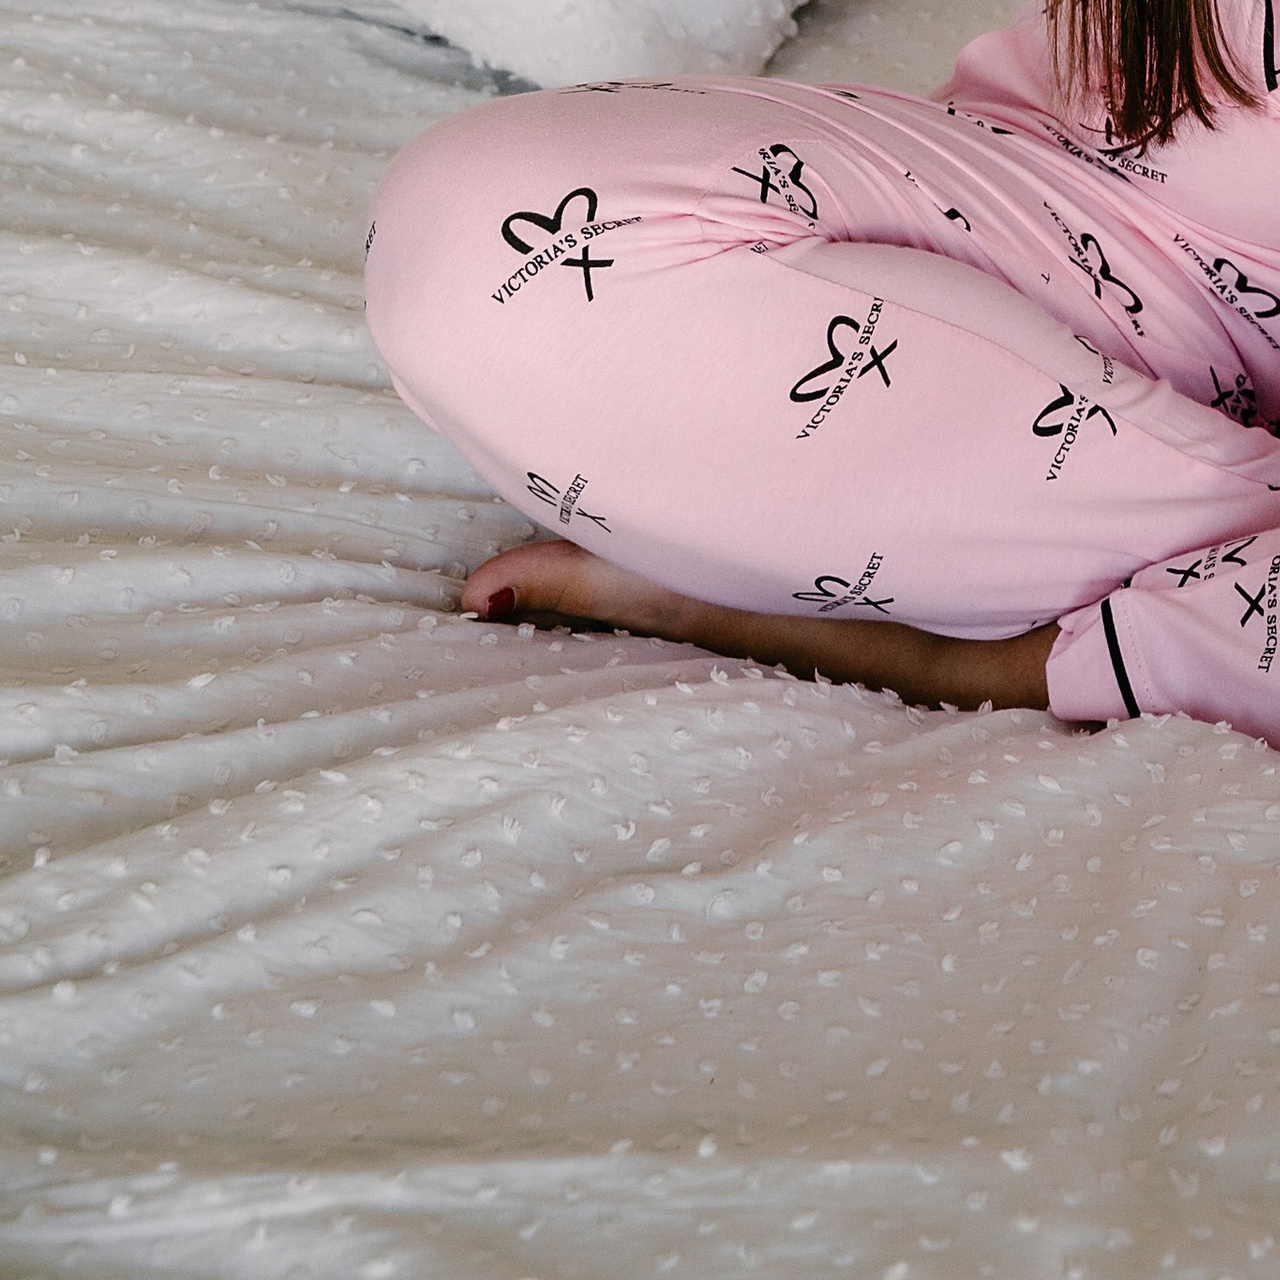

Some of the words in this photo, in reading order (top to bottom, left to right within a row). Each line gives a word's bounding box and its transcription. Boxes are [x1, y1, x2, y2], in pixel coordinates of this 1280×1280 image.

[1118, 158, 1168, 184] SECRET
[491, 233, 578, 305] VICTORIA'S
[580, 215, 644, 240] SECRET
[1173, 233, 1238, 305] VICTORIA'S
[796, 351, 864, 440] VICTORIA'S
[849, 552, 884, 596] SECRET
[1257, 614, 1278, 674] SECRET
